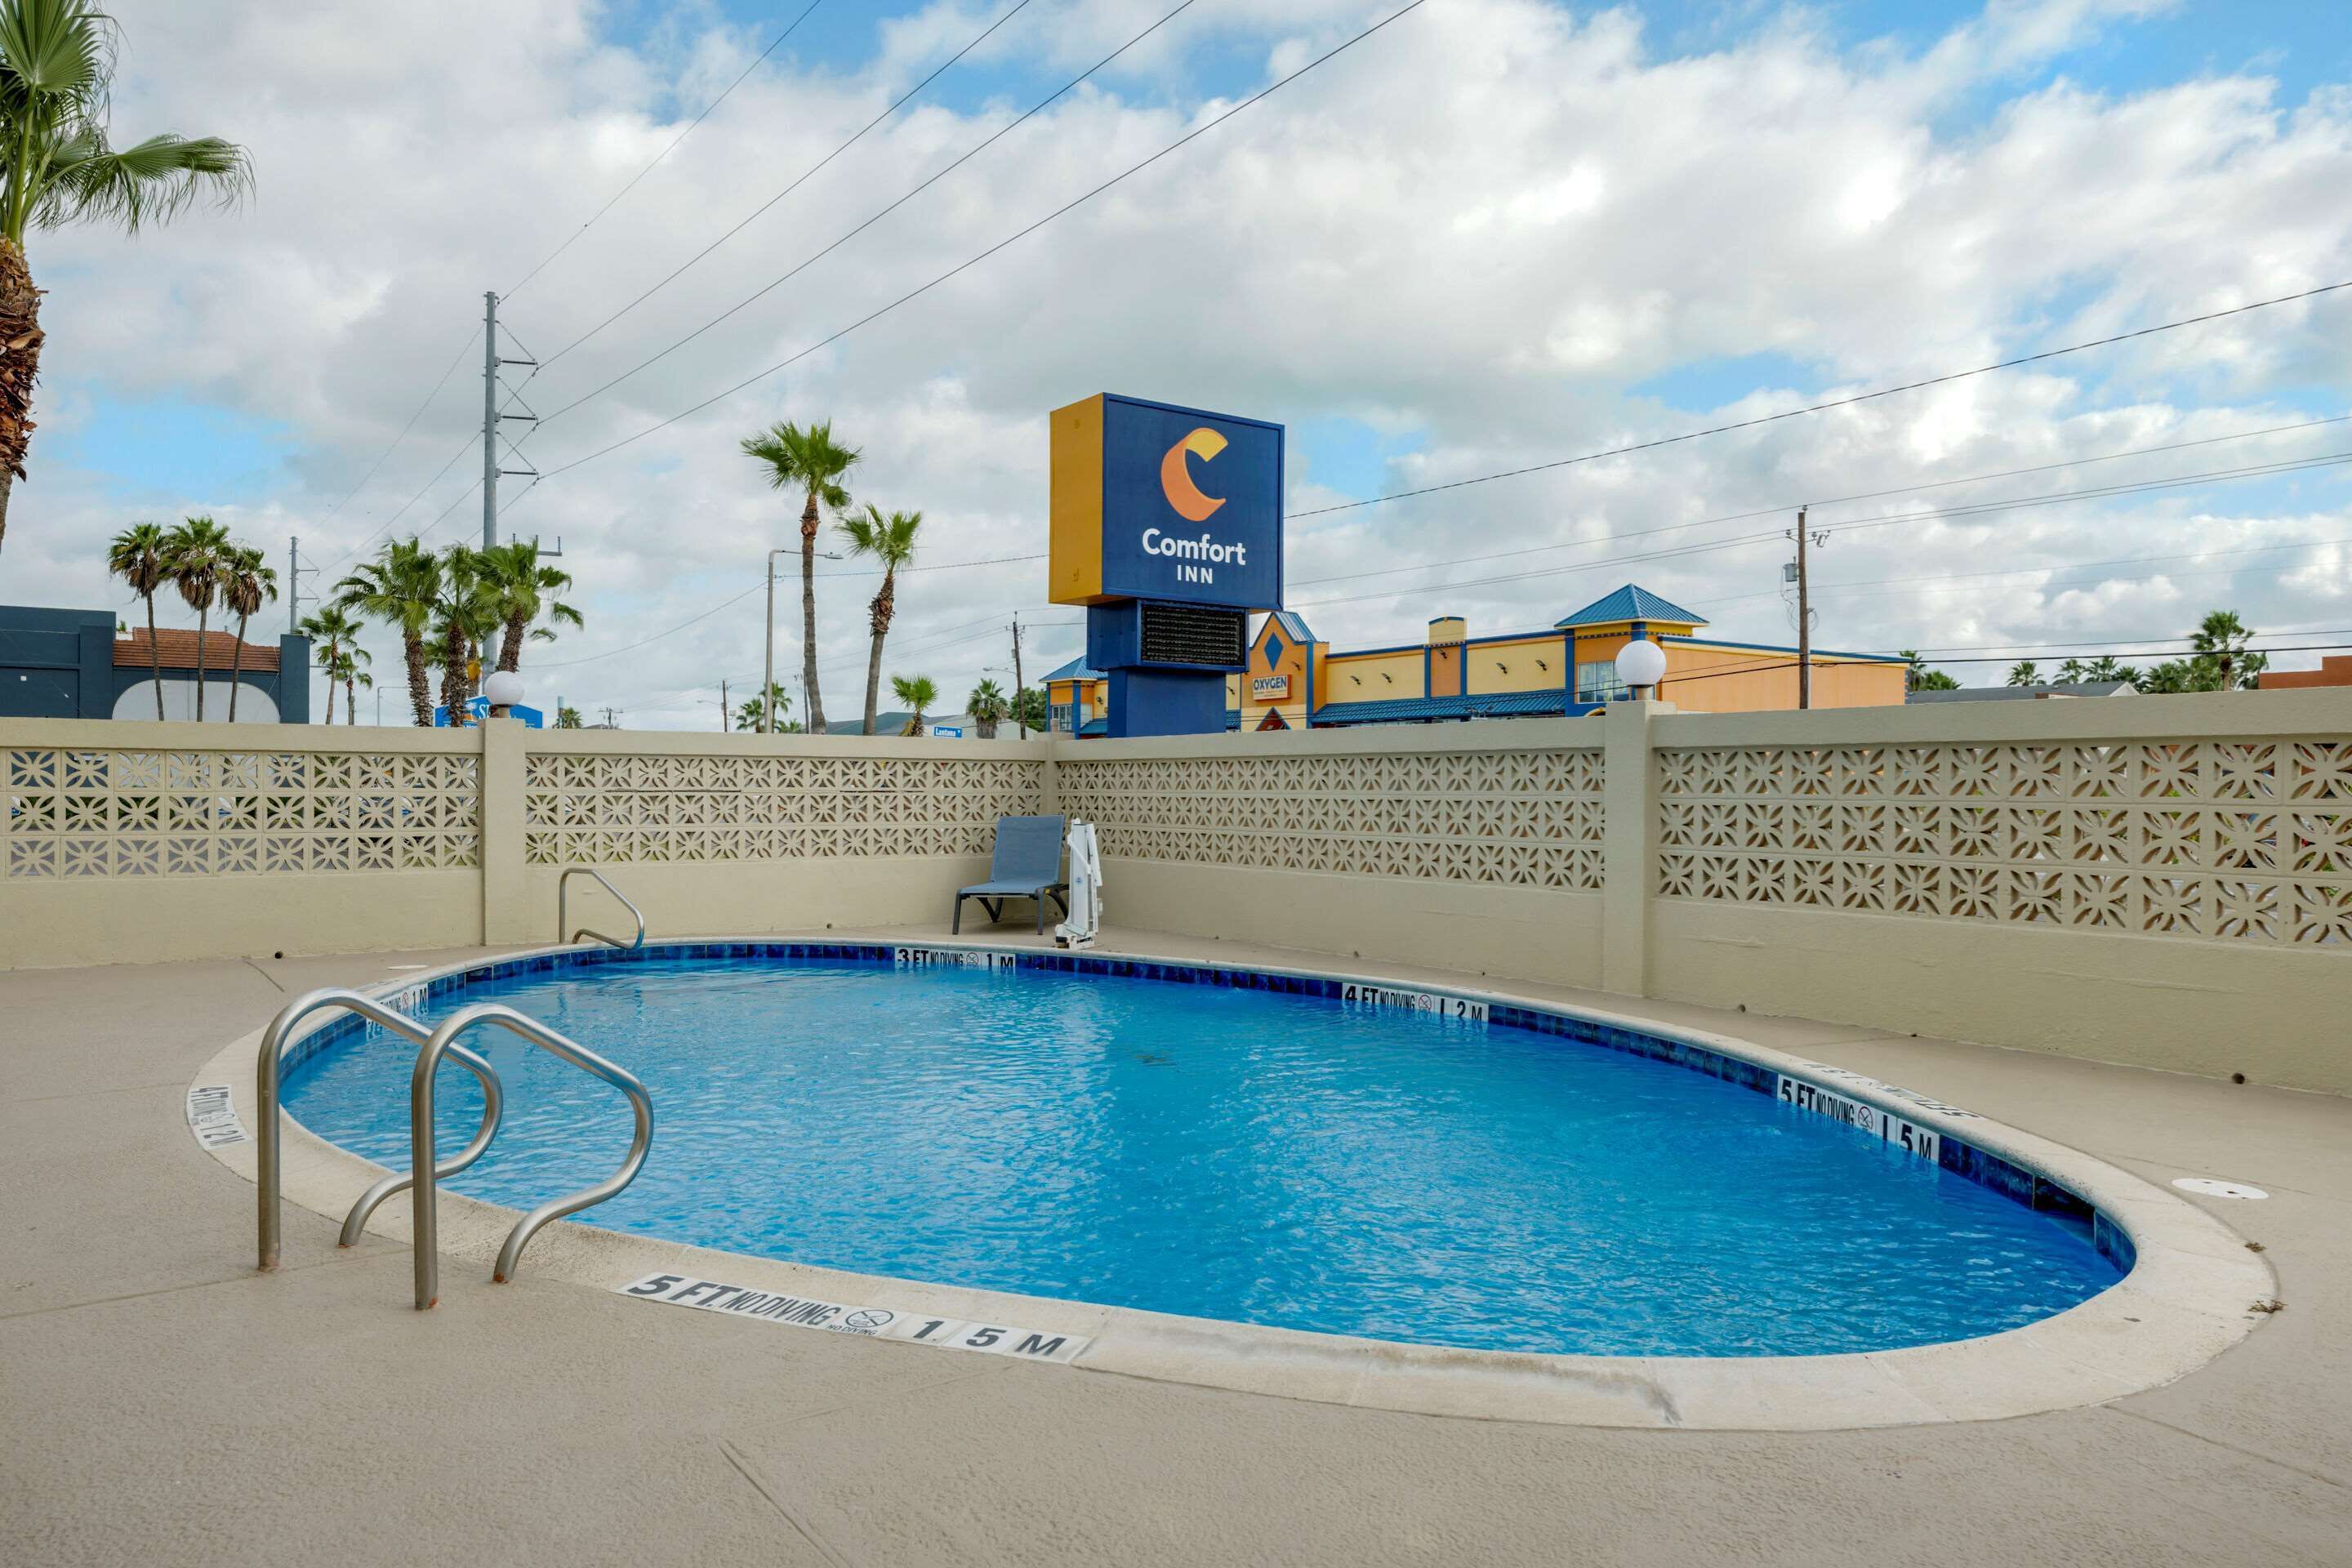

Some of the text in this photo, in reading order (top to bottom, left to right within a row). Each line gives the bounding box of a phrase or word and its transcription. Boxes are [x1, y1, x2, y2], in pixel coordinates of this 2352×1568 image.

[1142, 528, 1246, 566] Comfort
[1177, 564, 1213, 585] INN
[1253, 676, 1287, 691] OXYGEN
[912, 949, 929, 964] FT
[940, 952, 964, 967] DIVING
[1000, 956, 1013, 968] M
[1344, 985, 1357, 1000] 4
[1361, 987, 1379, 1004] FT
[1390, 991, 1415, 1011] DIVING
[1471, 1005, 1482, 1021] M
[1780, 1078, 1793, 1102] 5
[1797, 1083, 1815, 1111] FT
[1815, 1092, 1827, 1117] NO
[1827, 1097, 1855, 1126] DIVING
[1900, 1123, 1913, 1151] 5
[1919, 1133, 1932, 1160] M
[627, 1275, 686, 1295] 5
[719, 1291, 768, 1312] NO
[749, 1296, 842, 1326] DIVING
[1013, 1334, 1068, 1356] M
[841, 1326, 879, 1336] DIVING
